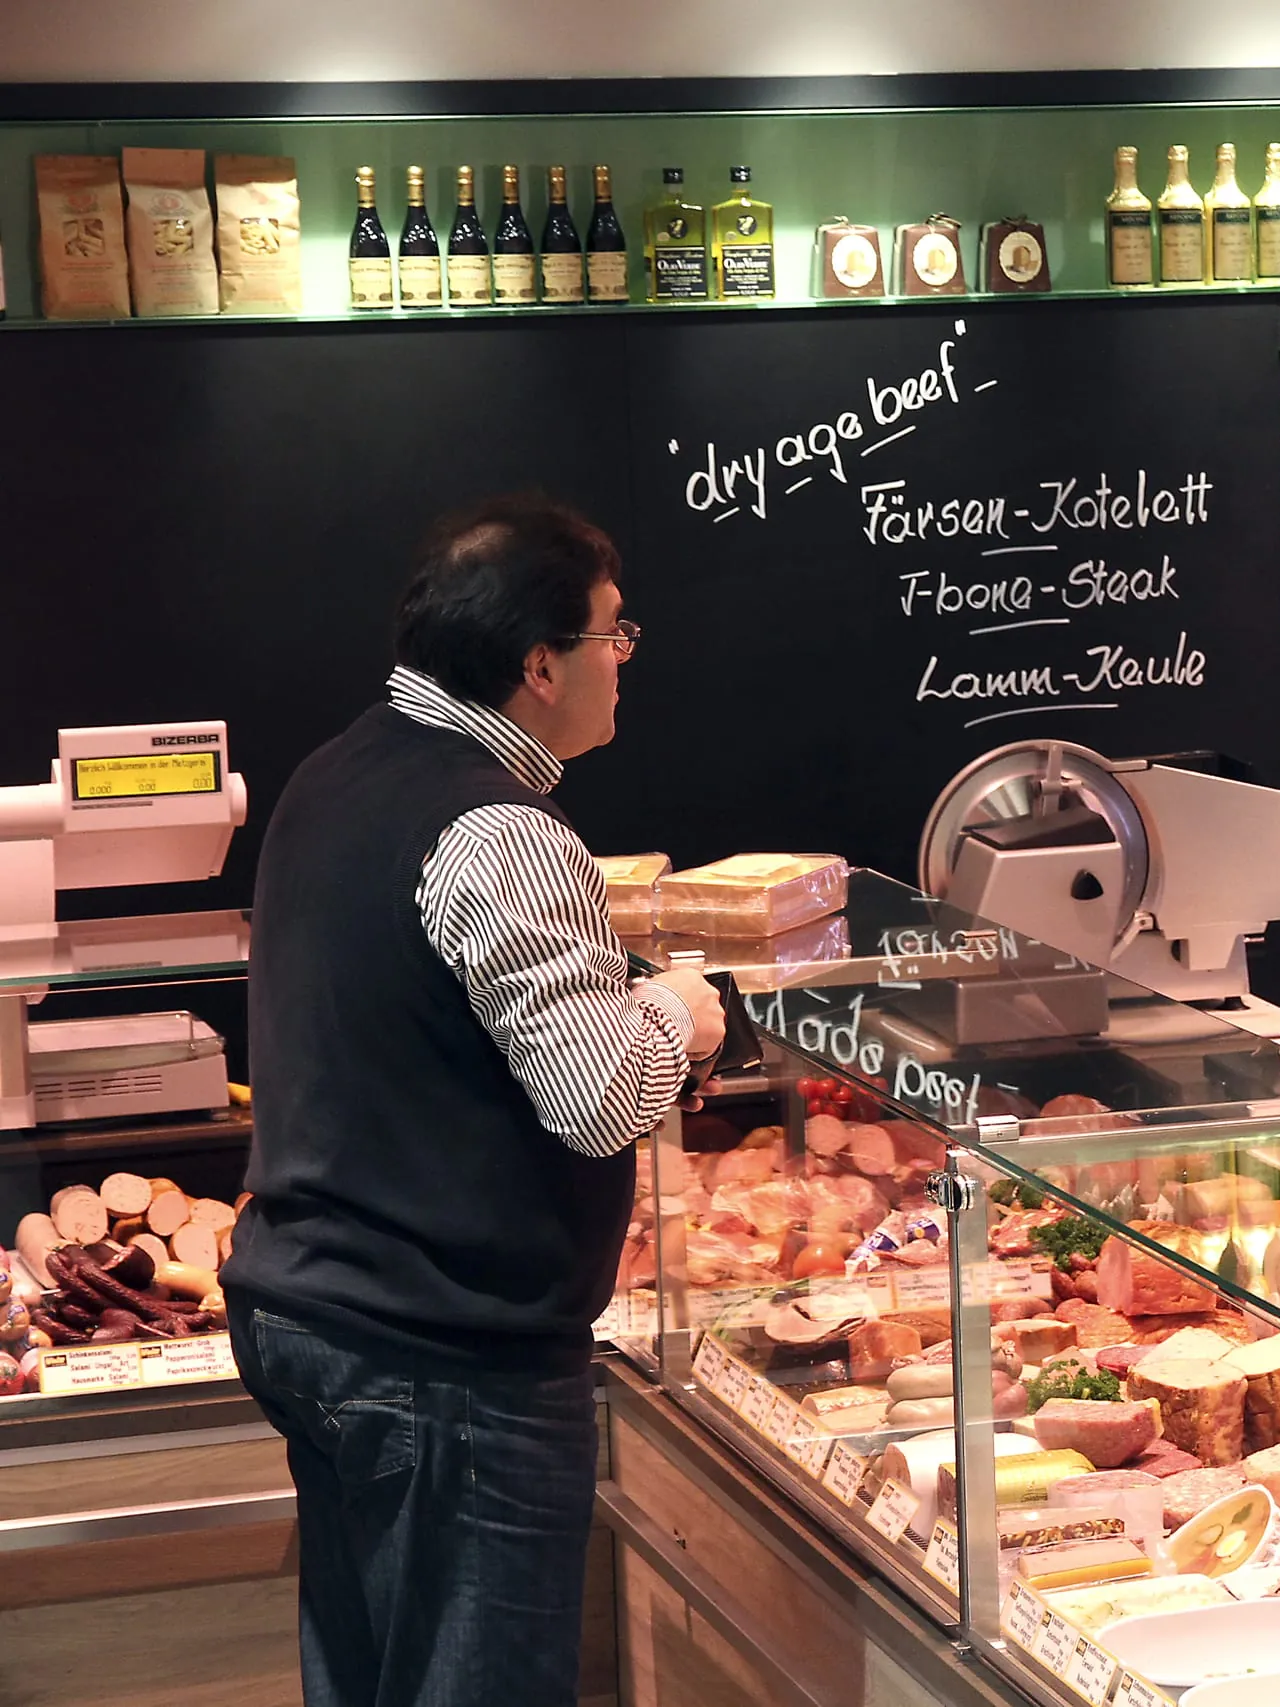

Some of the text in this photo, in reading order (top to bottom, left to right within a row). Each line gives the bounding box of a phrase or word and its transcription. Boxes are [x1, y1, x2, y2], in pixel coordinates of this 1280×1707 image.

[776, 412, 864, 483] age
[899, 556, 1179, 616] T-bone-Steak
[916, 632, 1207, 702] Lamm-Keule
[152, 734, 219, 747] BIZERBA
